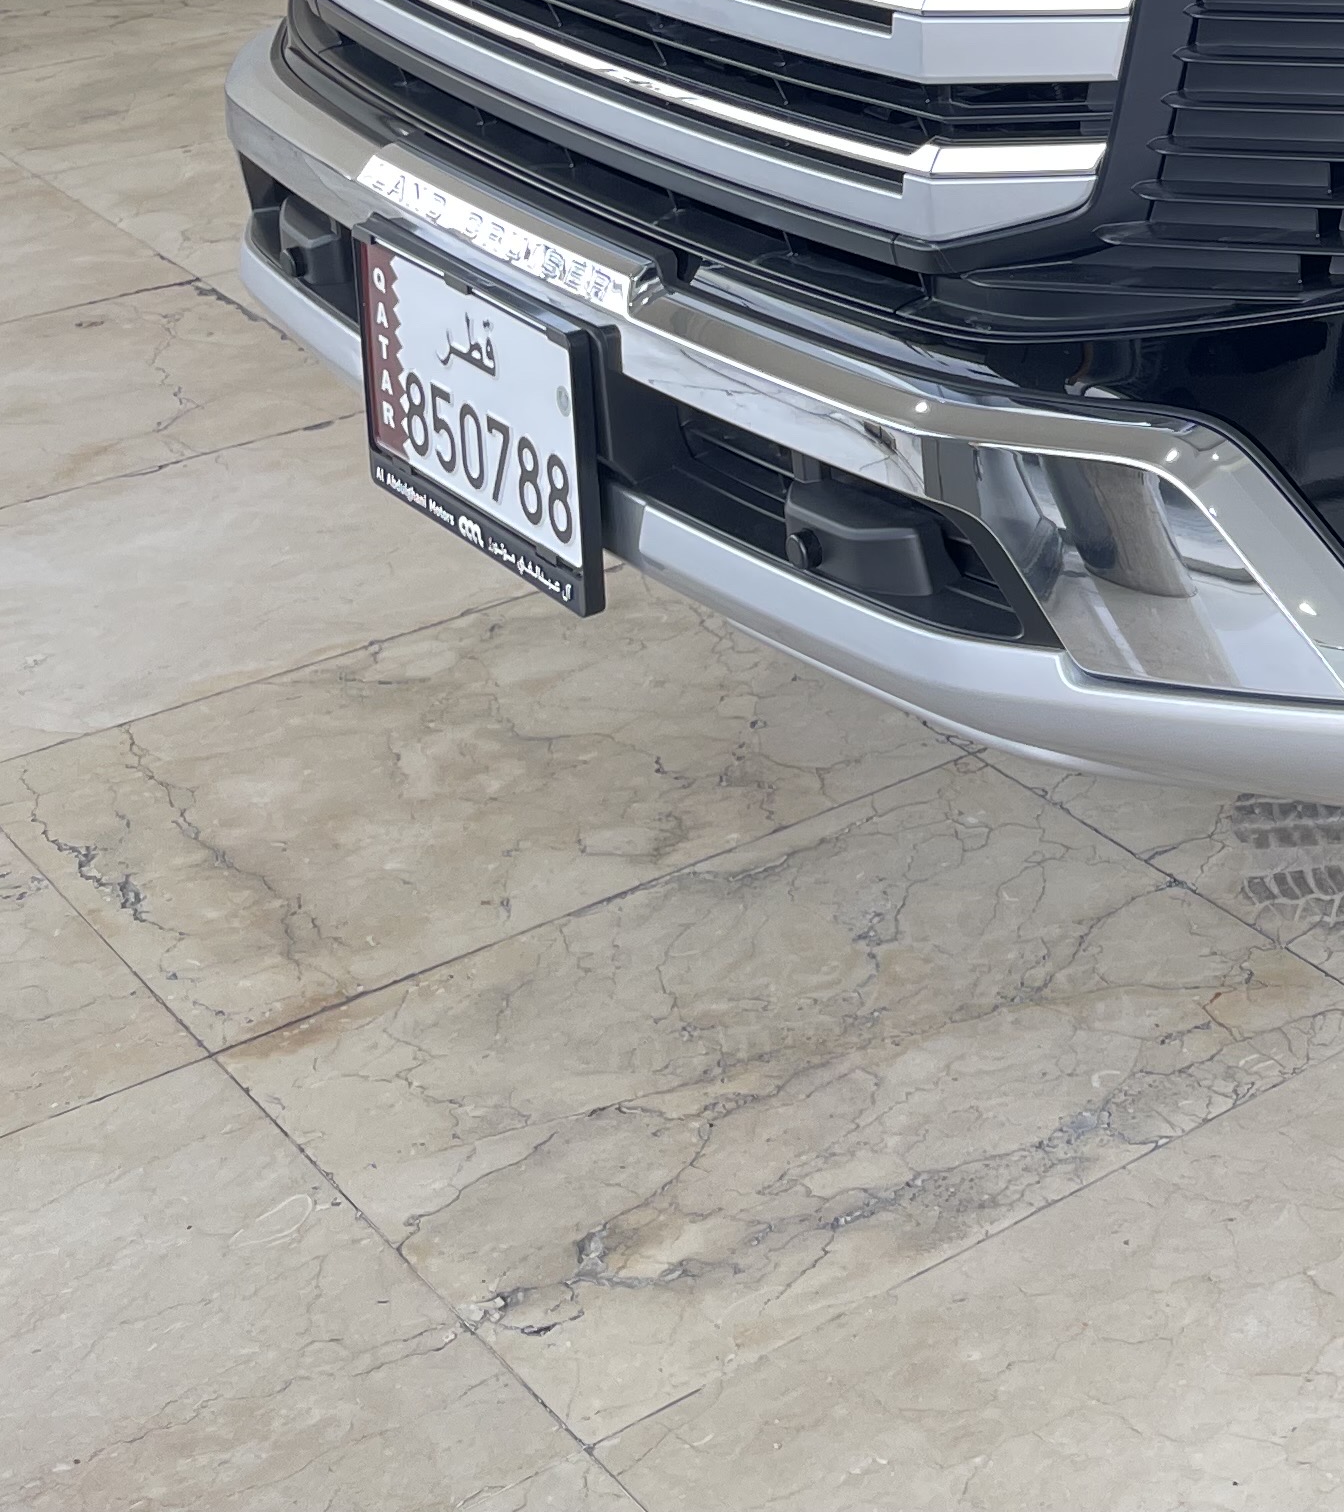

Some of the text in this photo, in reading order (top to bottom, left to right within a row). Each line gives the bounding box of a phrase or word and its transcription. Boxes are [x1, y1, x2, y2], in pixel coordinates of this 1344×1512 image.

[371, 266, 396, 430] QATAR
[435, 311, 498, 378] قطر
[404, 371, 574, 545] 850788
